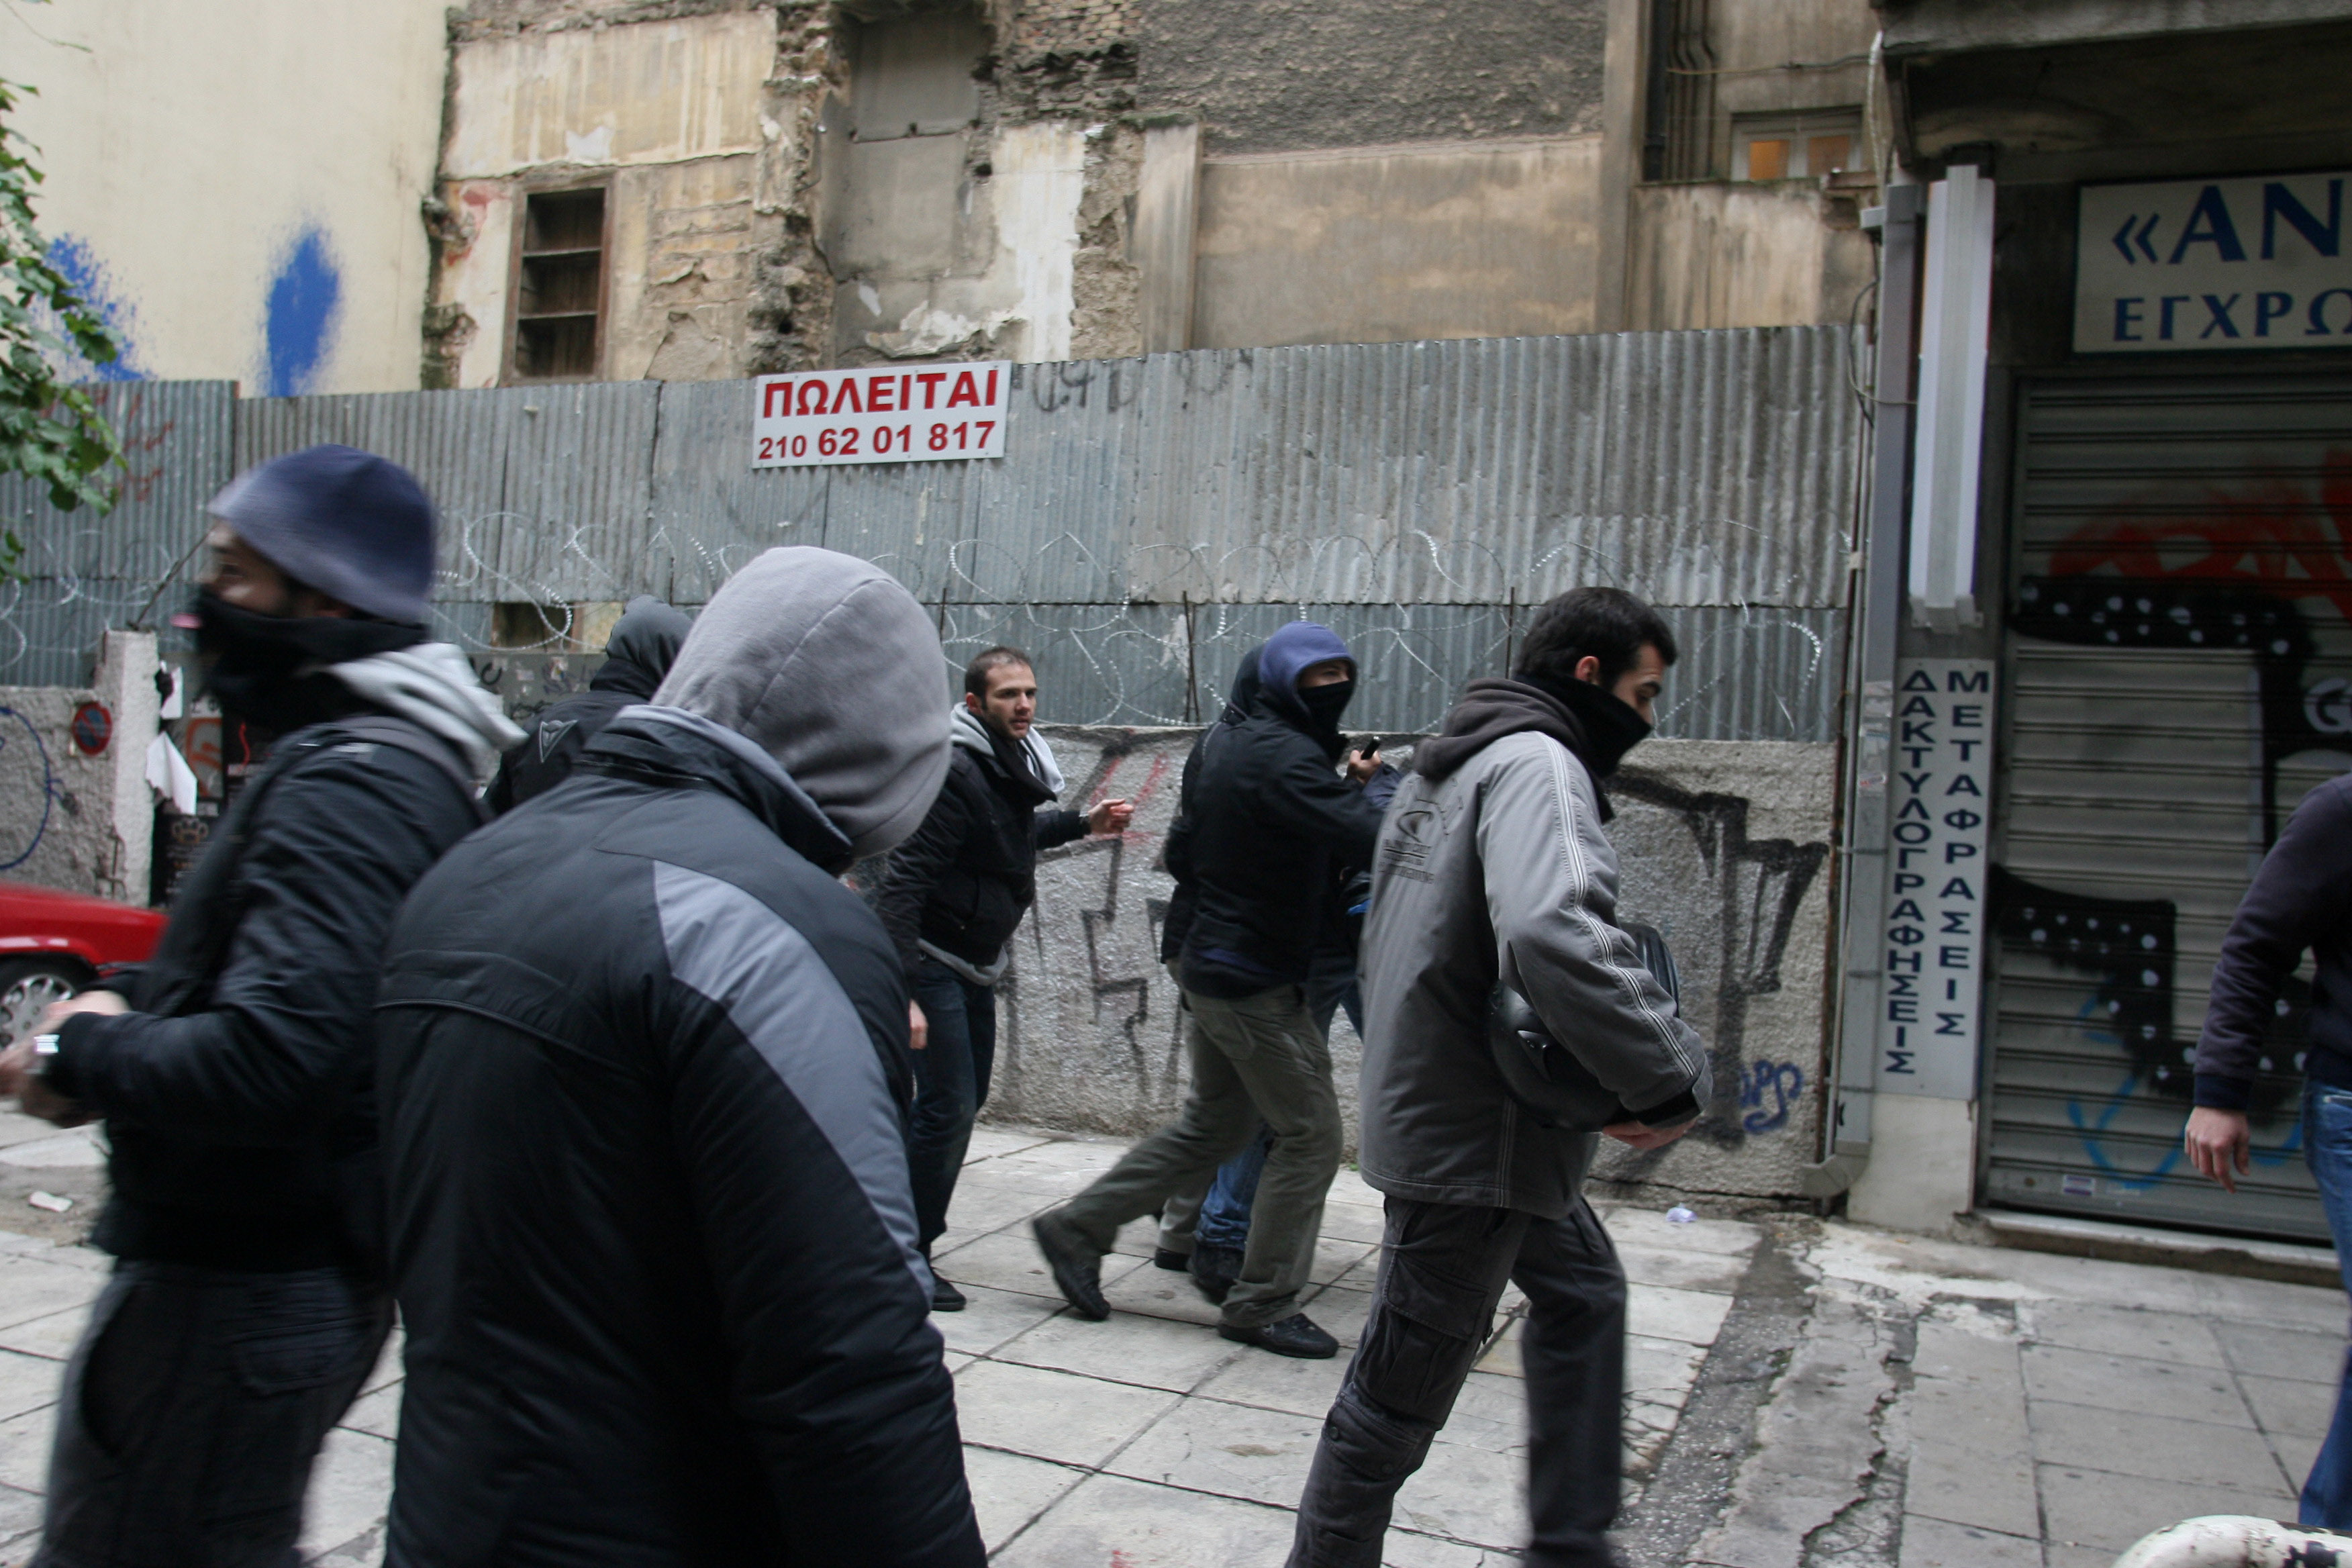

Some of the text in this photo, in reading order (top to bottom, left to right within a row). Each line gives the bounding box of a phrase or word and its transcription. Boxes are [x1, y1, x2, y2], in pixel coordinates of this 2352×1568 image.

[758, 421, 996, 460] 210 62 01 817
[763, 369, 998, 419] ΠΩΛΕΙΤΑΙ
[1885, 670, 1937, 1074] ΔΑΚΤΥΛΟΓΡΑΦΗΣΕΙΣ
[1934, 670, 1989, 1036] ΜΕΤΑΦΡΑΣΕΙΣ
